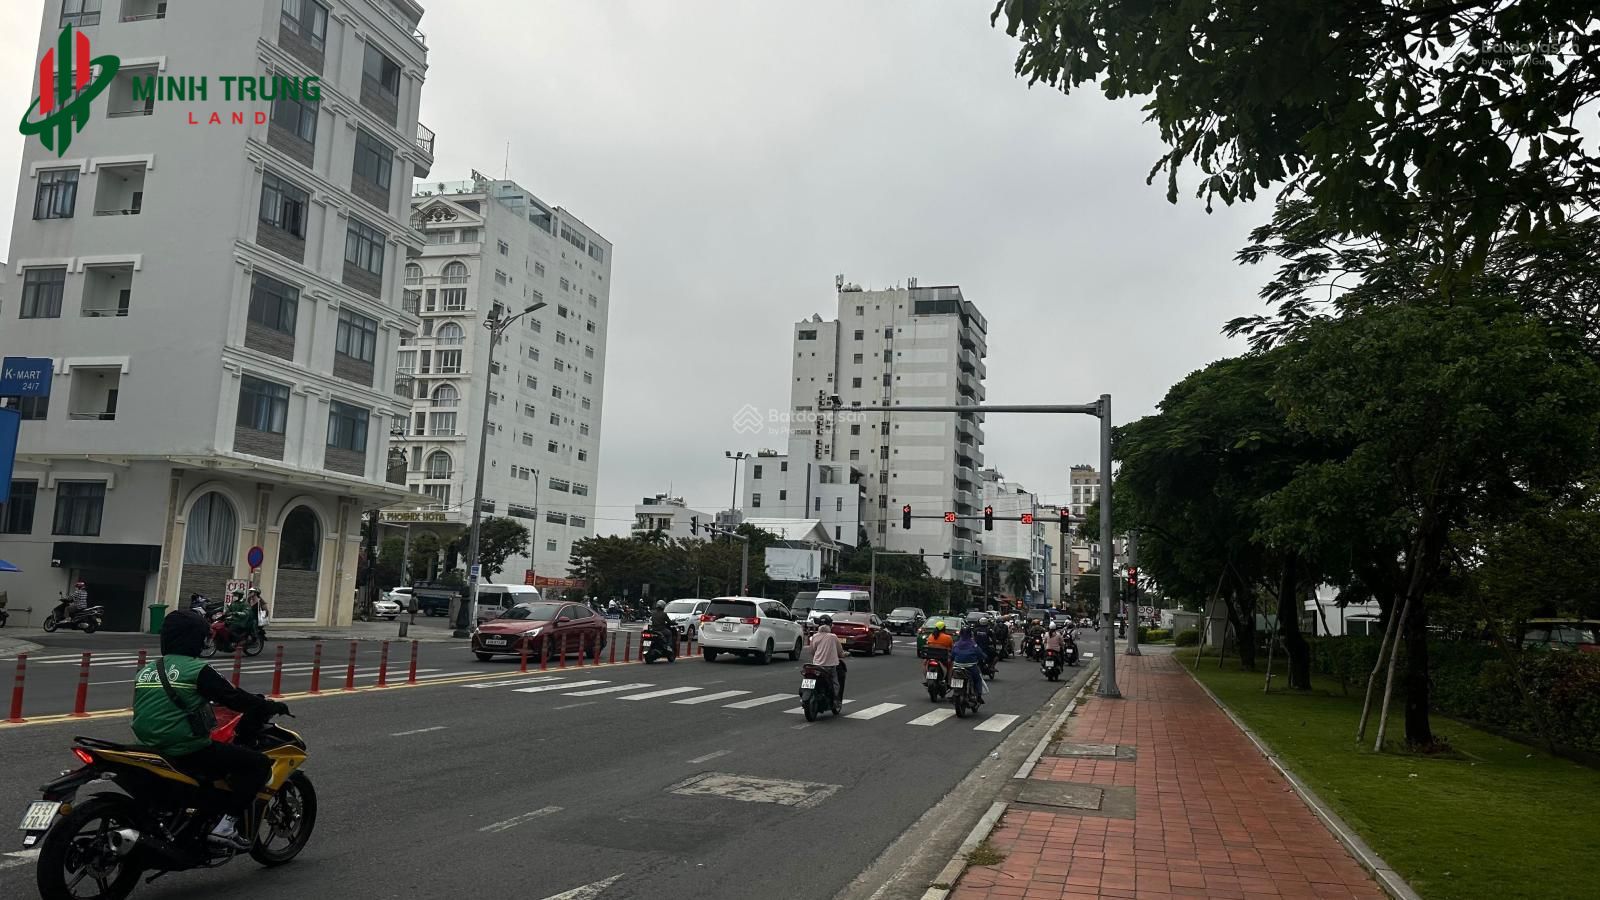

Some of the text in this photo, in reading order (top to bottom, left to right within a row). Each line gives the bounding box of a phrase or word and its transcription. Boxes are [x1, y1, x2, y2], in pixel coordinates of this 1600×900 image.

[5, 368, 41, 380] K-MART
[22, 382, 40, 391] 24/7
[422, 512, 448, 521] HOTEL
